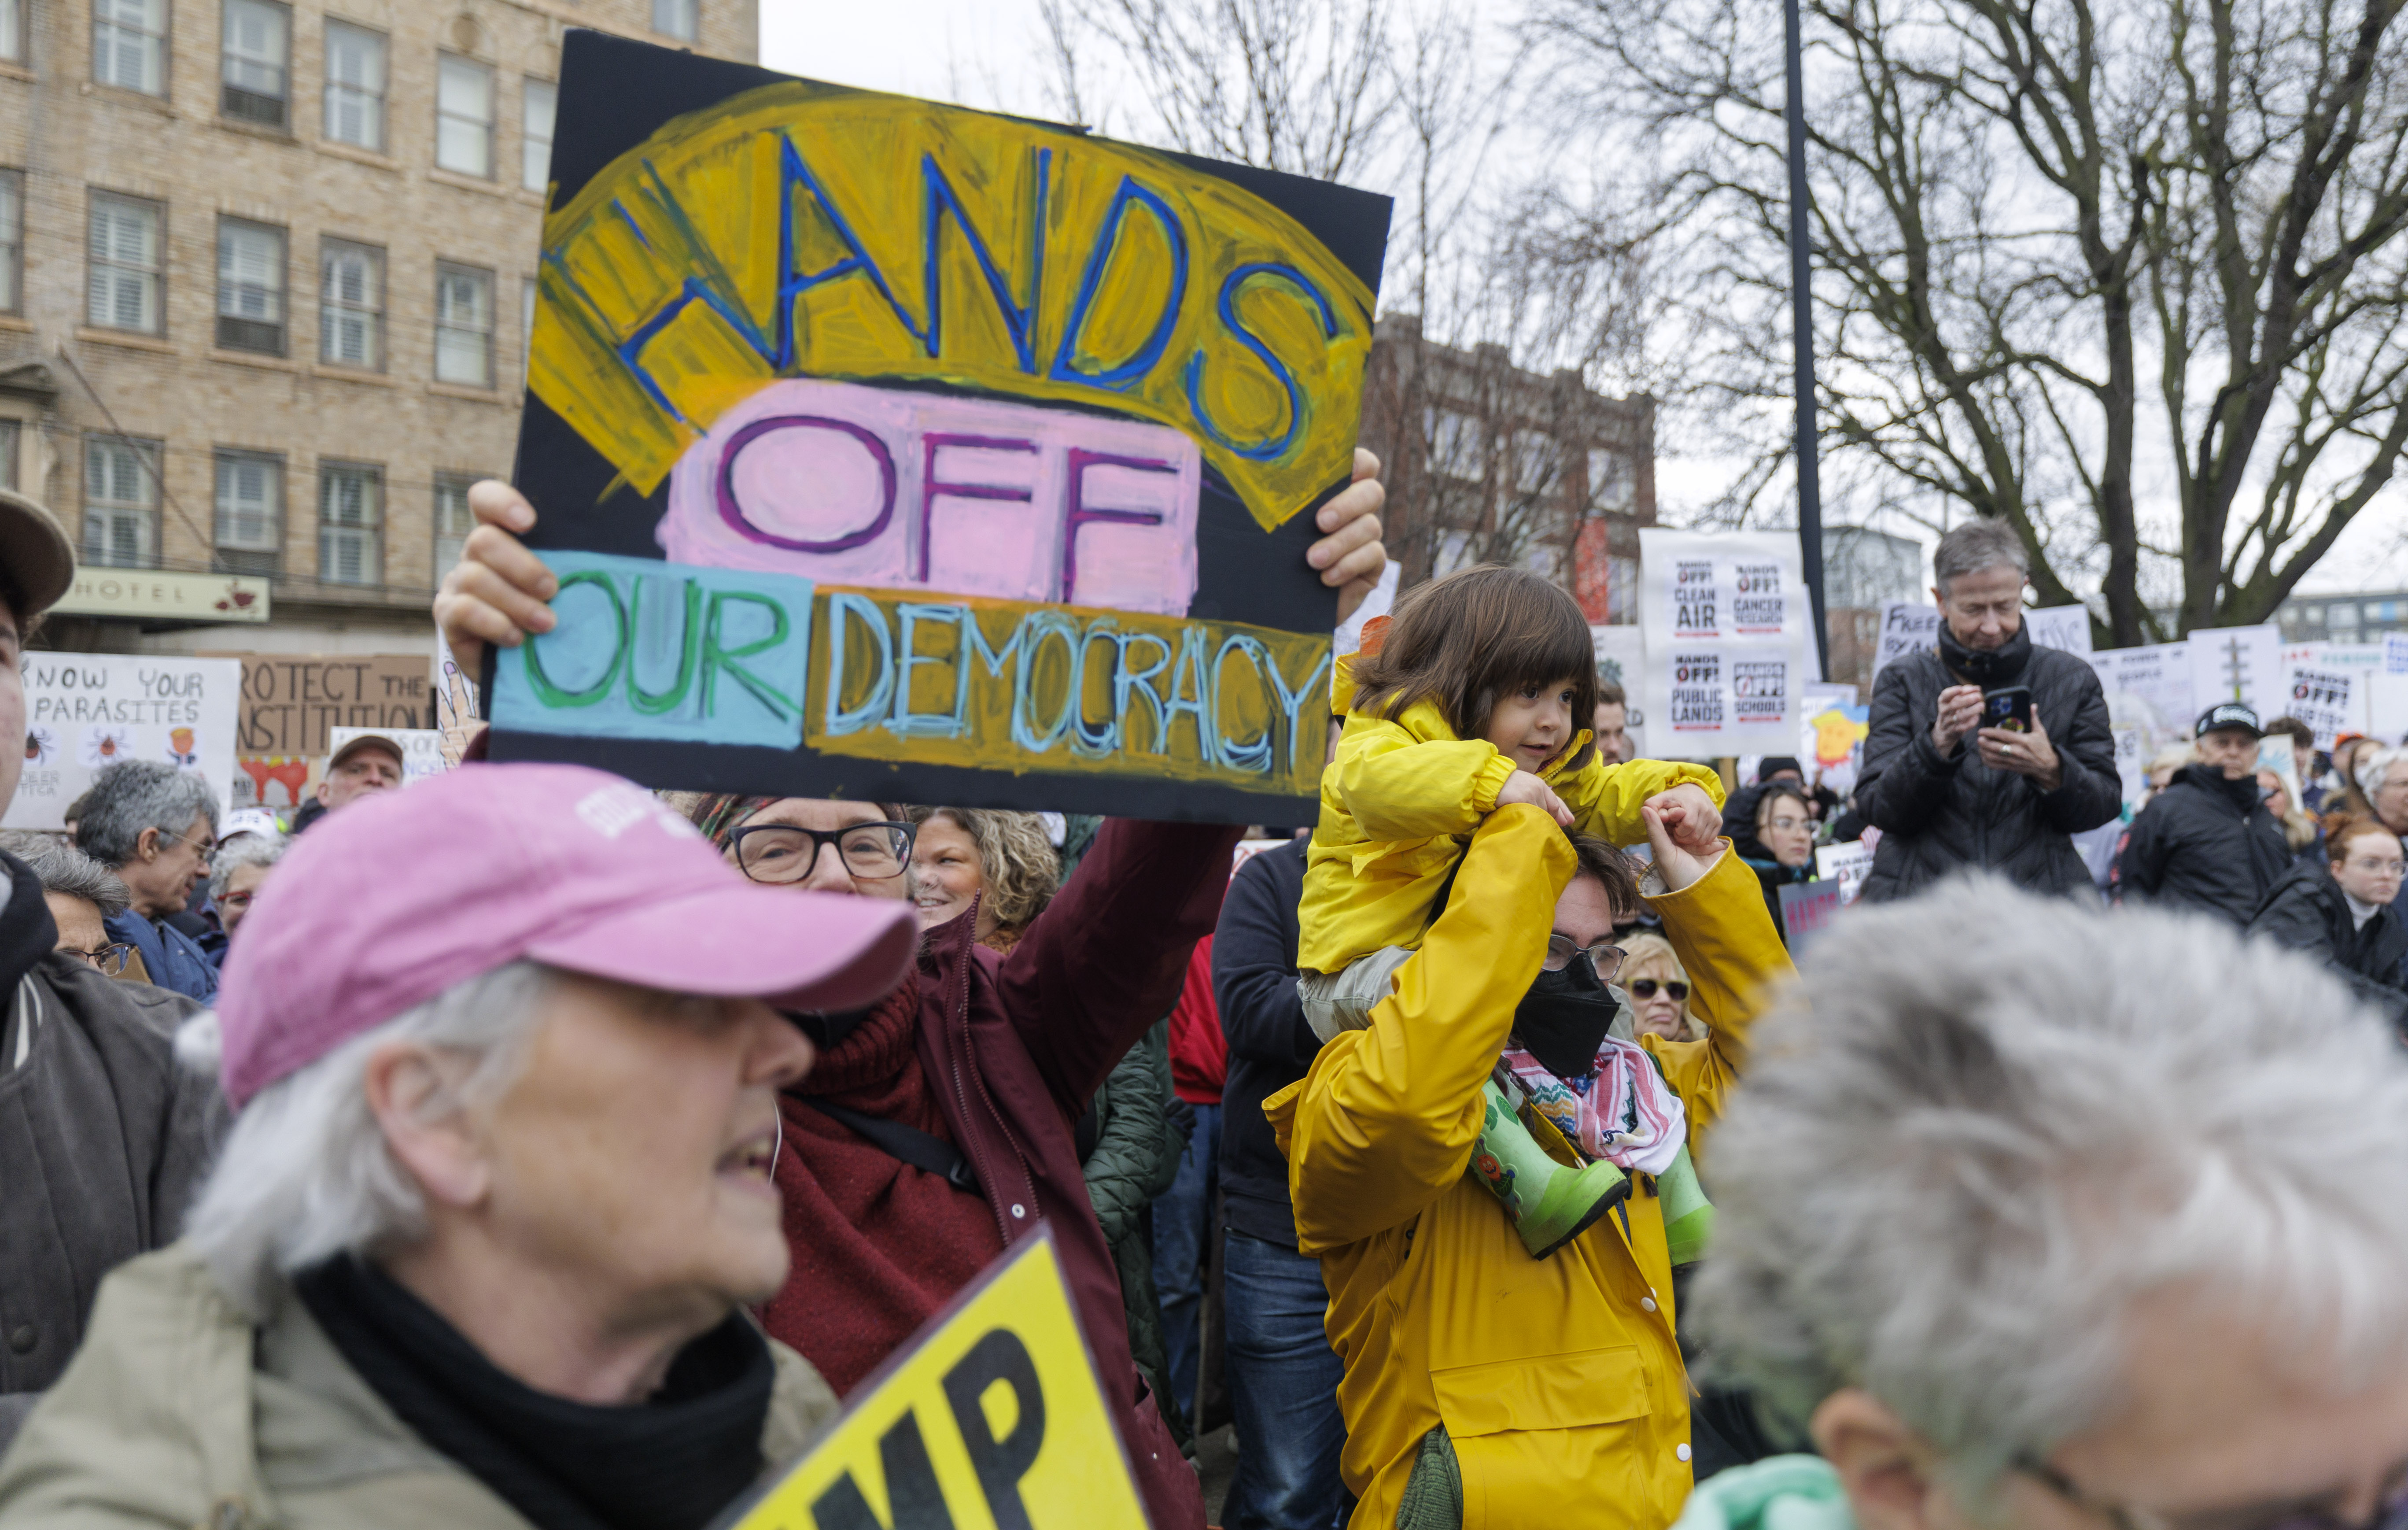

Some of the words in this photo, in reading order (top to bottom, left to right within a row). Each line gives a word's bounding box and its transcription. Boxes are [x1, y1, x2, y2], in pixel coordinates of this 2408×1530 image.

[542, 132, 1339, 463] HANDS
[715, 414, 1180, 607] OFF
[1677, 571, 1712, 584] OFF!
[1736, 565, 1778, 574] HANDS
[75, 580, 185, 602] HOTEL
[1737, 578, 1780, 593] OFF!
[1674, 588, 1715, 602] CLEAN
[1733, 599, 1782, 612] CANCER
[1677, 605, 1716, 629] AIR
[1675, 654, 1719, 664] HANDS
[522, 569, 805, 722] OUR
[826, 591, 1333, 773] DEMOCRACY
[1676, 666, 1719, 683] OFF!
[2295, 668, 2351, 686] HANDS
[139, 668, 204, 698] YOUR
[380, 675, 425, 698] THE
[1672, 688, 1723, 705] PUBLIC
[2293, 683, 2350, 709] OFF!
[34, 696, 200, 724] PARASITES
[1671, 706, 1723, 723] LANDS
[1734, 701, 1785, 713] SCHOOLS
